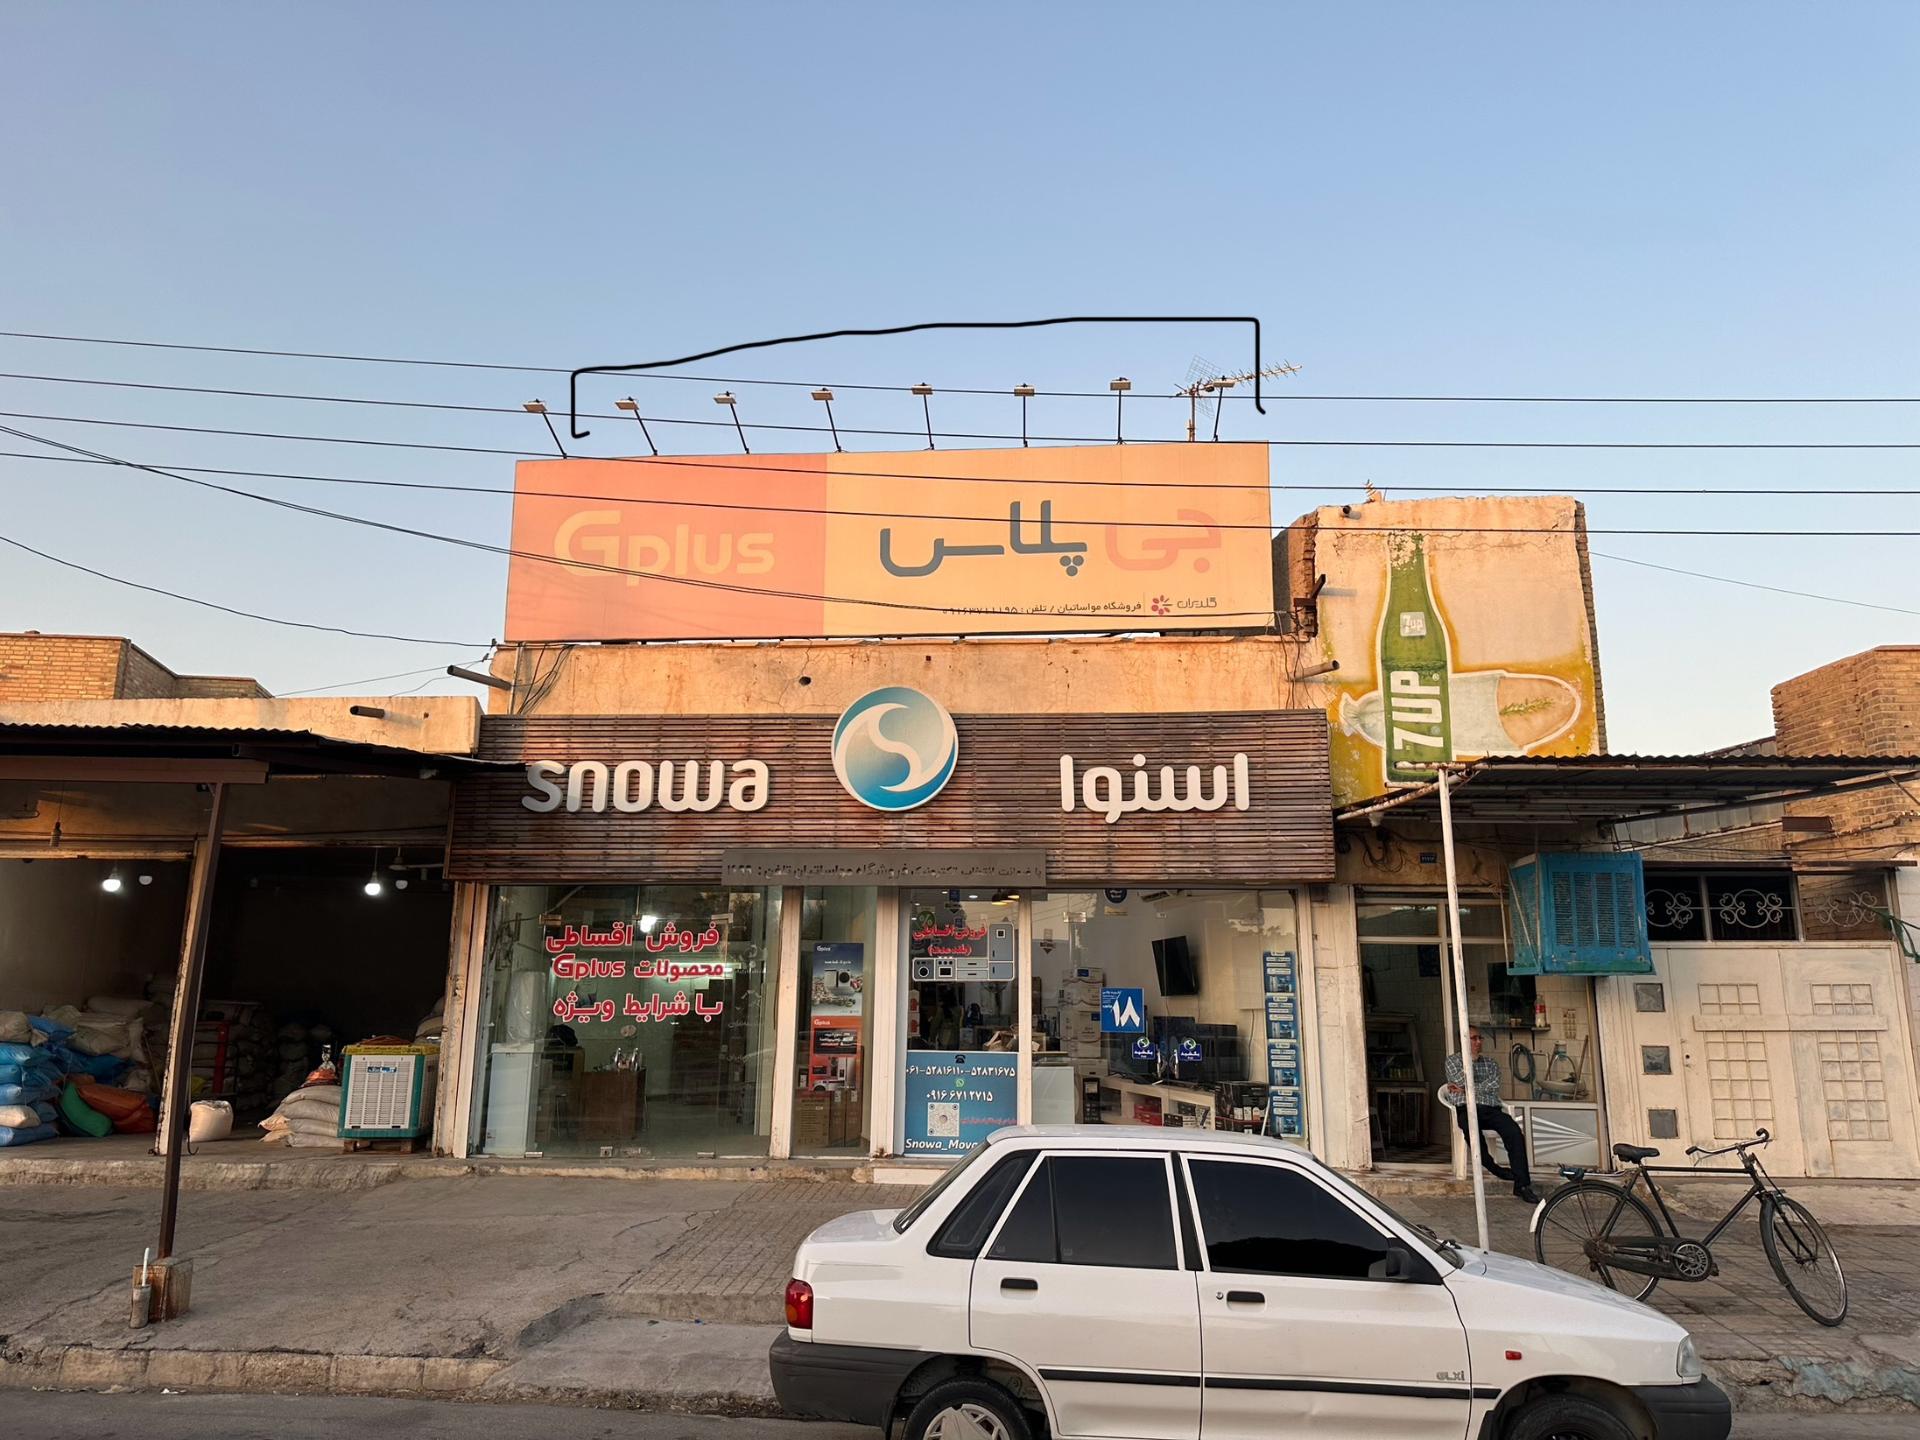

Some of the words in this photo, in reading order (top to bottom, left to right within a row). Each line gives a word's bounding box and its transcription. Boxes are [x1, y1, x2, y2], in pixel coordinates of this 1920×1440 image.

[554, 509, 775, 585] Gplus
[879, 500, 1088, 577] پلاس
[1107, 508, 1223, 573] جی
[1103, 600, 1142, 613] فروشگاه
[1391, 670, 1444, 751] 7UP
[521, 757, 769, 813] snowa
[1060, 751, 1250, 824] اسنوا
[546, 921, 634, 953] اقساطی
[645, 920, 720, 952] فروش
[553, 953, 626, 982] Gplus
[633, 959, 725, 984] محصولات
[552, 990, 617, 1023] ویژه
[622, 990, 691, 1024] شرایط
[694, 994, 725, 1023] با
